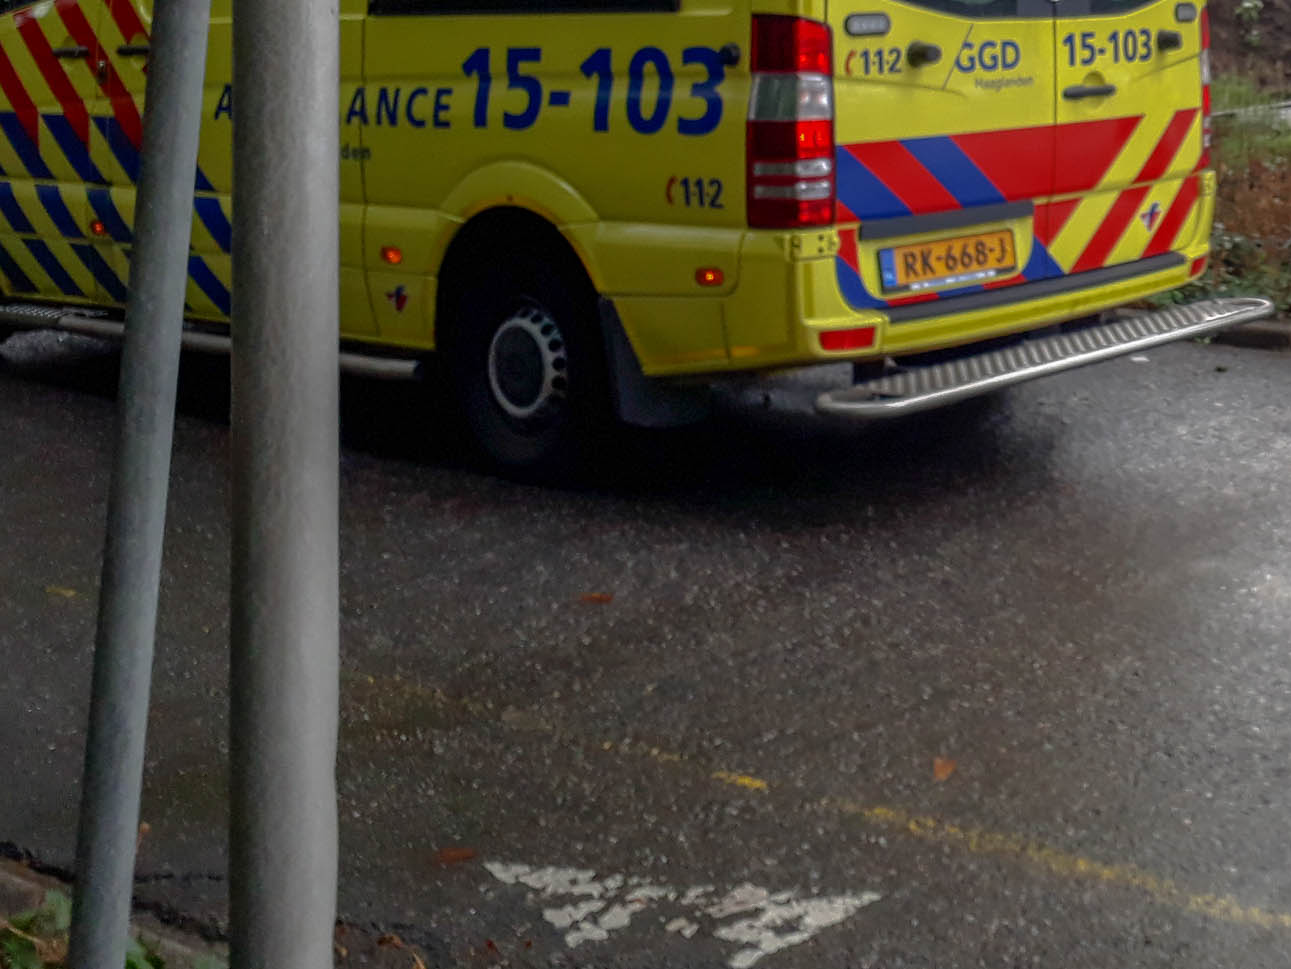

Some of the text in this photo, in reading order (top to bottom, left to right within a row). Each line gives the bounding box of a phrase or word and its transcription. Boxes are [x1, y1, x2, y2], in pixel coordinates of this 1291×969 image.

[955, 40, 1022, 73] GGD
[1063, 29, 1152, 67] 15-103
[462, 46, 727, 136] 15-103
[903, 237, 1008, 279] RK-668-J
